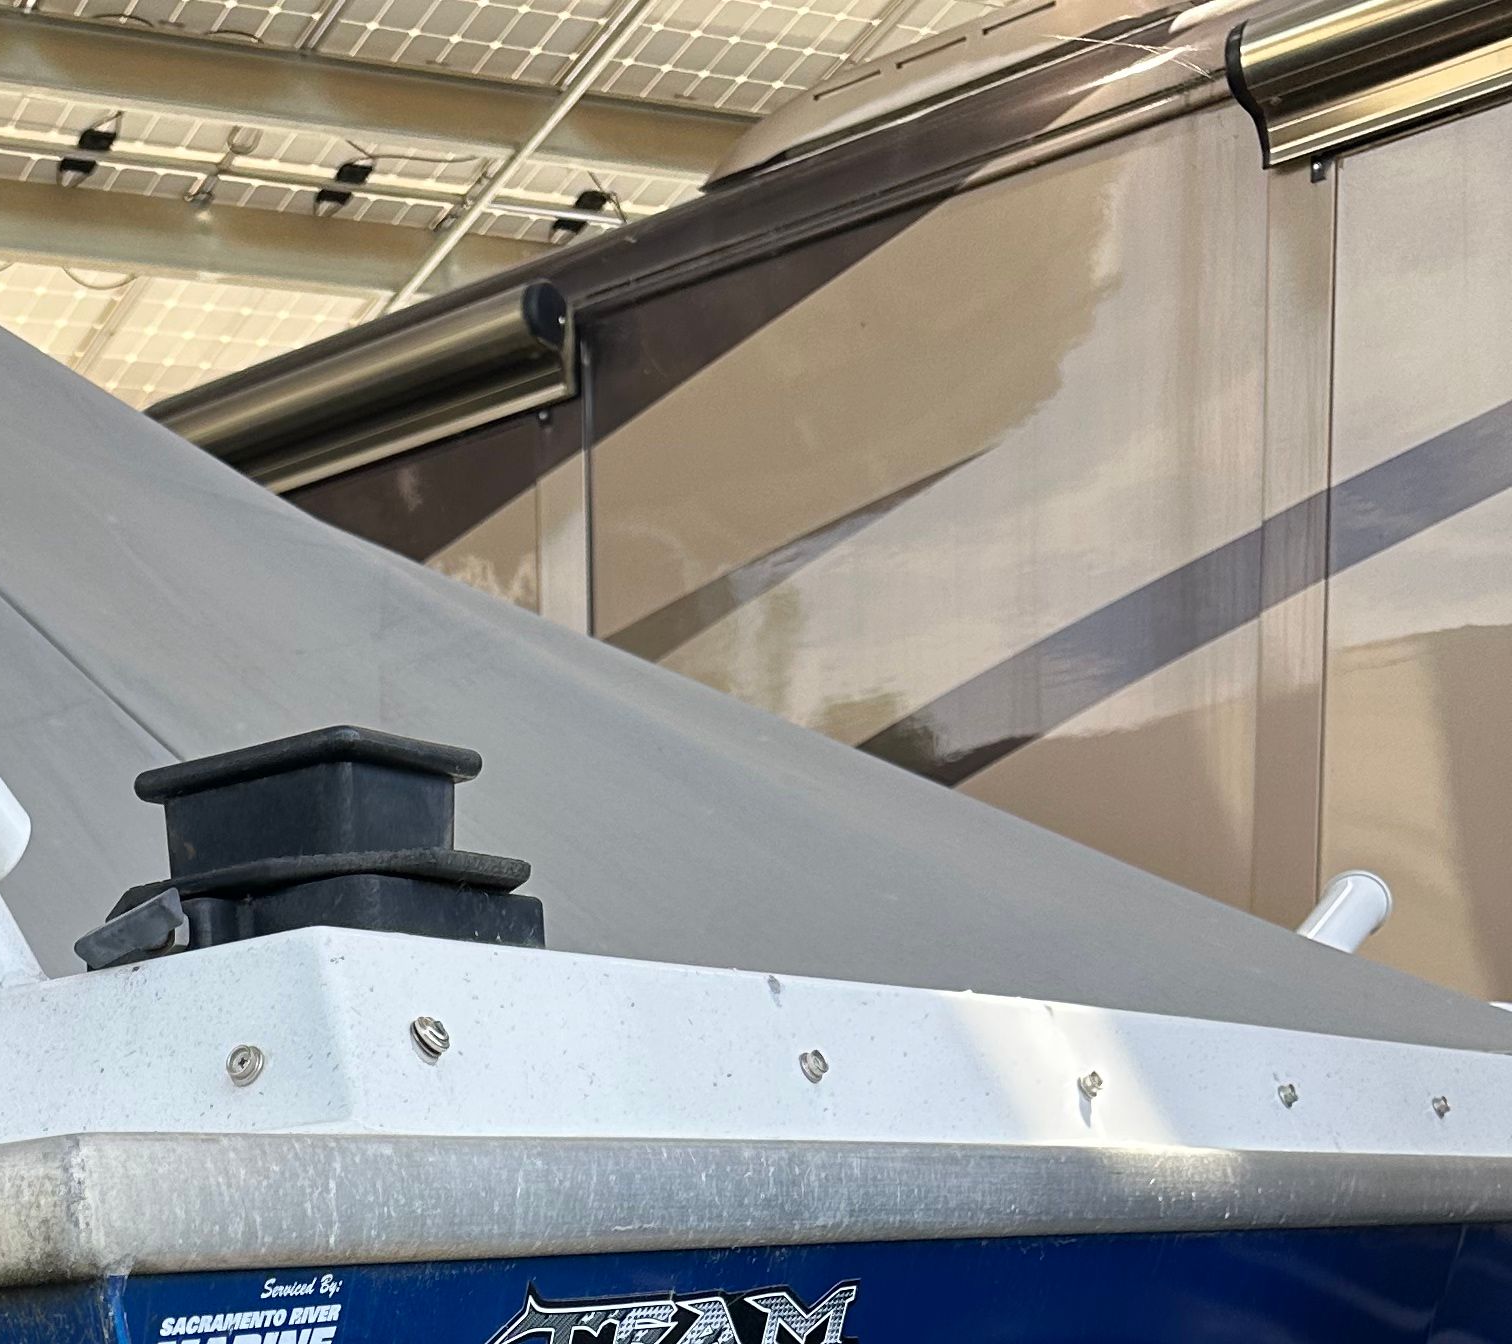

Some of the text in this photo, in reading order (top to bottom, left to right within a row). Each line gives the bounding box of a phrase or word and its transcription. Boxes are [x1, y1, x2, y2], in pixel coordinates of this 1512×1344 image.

[261, 1273, 343, 1299] Serviced By:
[159, 1303, 342, 1337] SACRAMENTO RIVER
